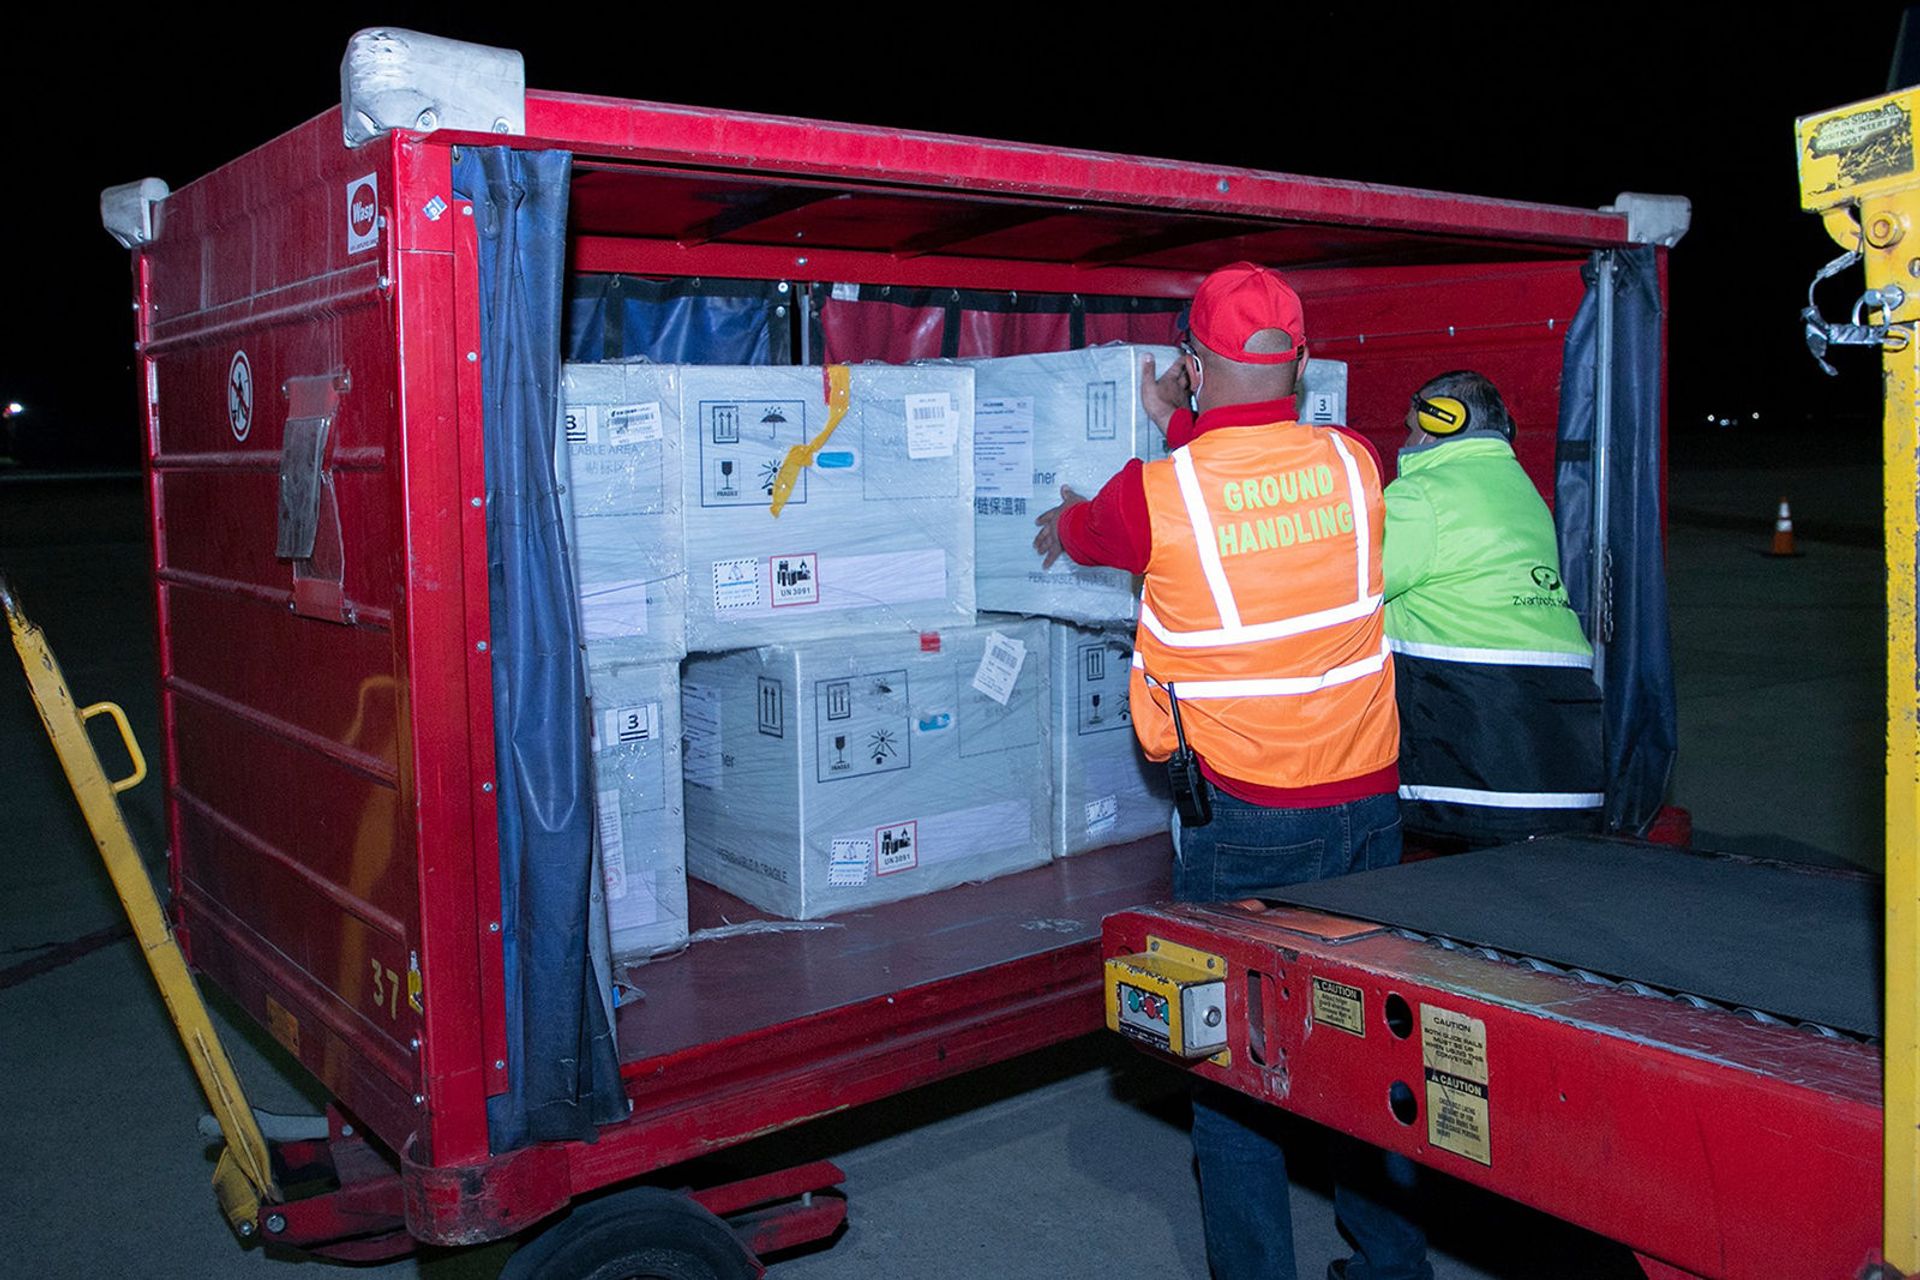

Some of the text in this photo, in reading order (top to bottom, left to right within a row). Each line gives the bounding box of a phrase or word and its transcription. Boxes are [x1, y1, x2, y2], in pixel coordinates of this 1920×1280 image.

[353, 200, 374, 224] Wasp
[1319, 399, 1327, 411] 3
[1223, 464, 1334, 512] GROUND
[974, 496, 1028, 515] 链保温箱
[1218, 501, 1354, 557] HANDLING
[780, 587, 811, 597] UN 3091
[628, 714, 639, 730] 3
[884, 858, 894, 866] UN
[371, 958, 399, 1021] 37
[1321, 981, 1358, 1000] CAUTION
[1433, 1017, 1471, 1033] CAUTION
[1424, 1027, 1441, 1037] BOTH
[1463, 1038, 1483, 1049] RAILS
[1433, 1036, 1452, 1046] MUST
[1435, 1050, 1473, 1066] CONVEYOR
[1440, 1074, 1482, 1096] CAUTION
